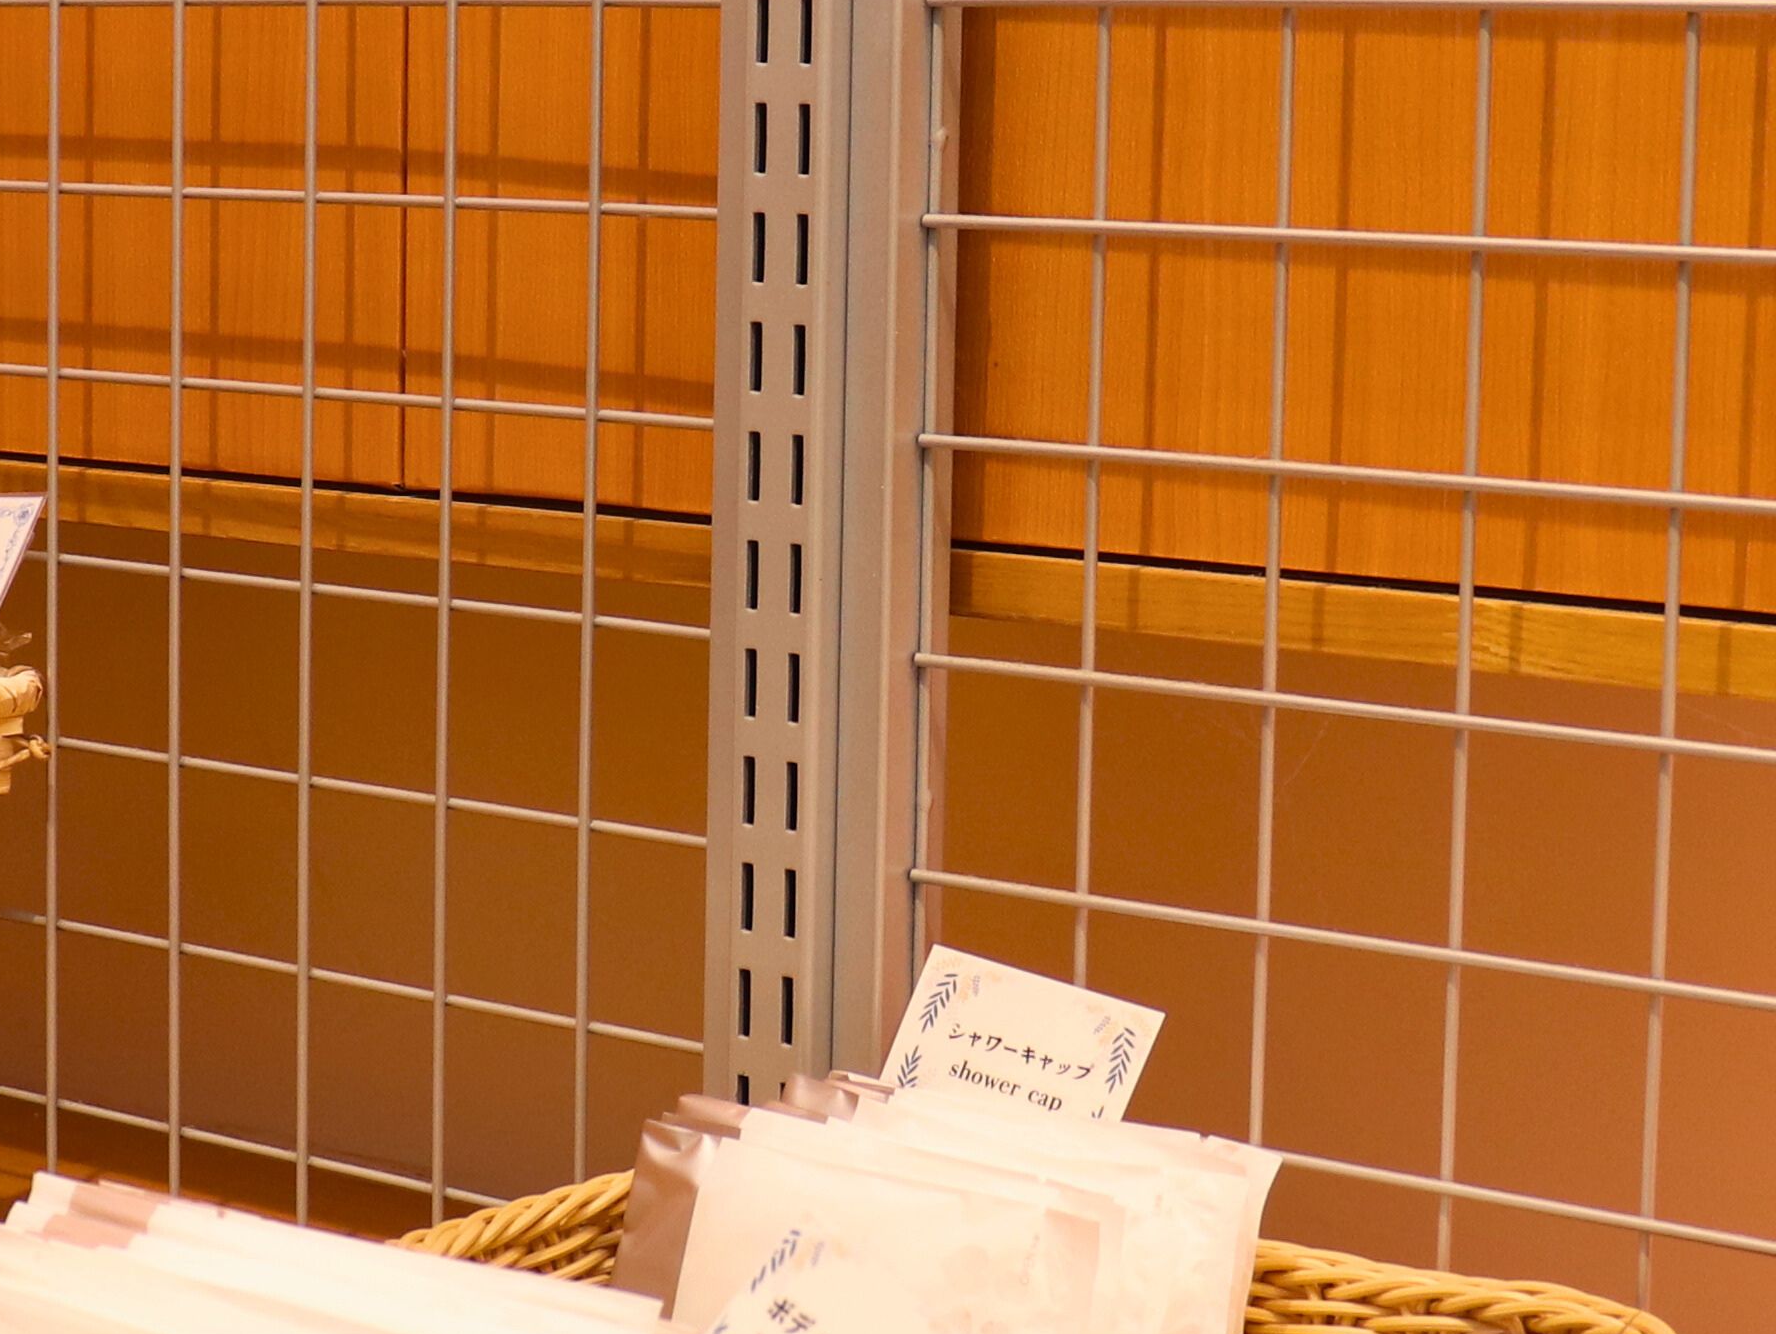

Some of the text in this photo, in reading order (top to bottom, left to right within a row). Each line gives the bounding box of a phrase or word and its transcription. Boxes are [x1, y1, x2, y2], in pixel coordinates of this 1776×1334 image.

[947, 1022, 1096, 1082] シャワーキャップ
[948, 1060, 1064, 1113] shower cap
